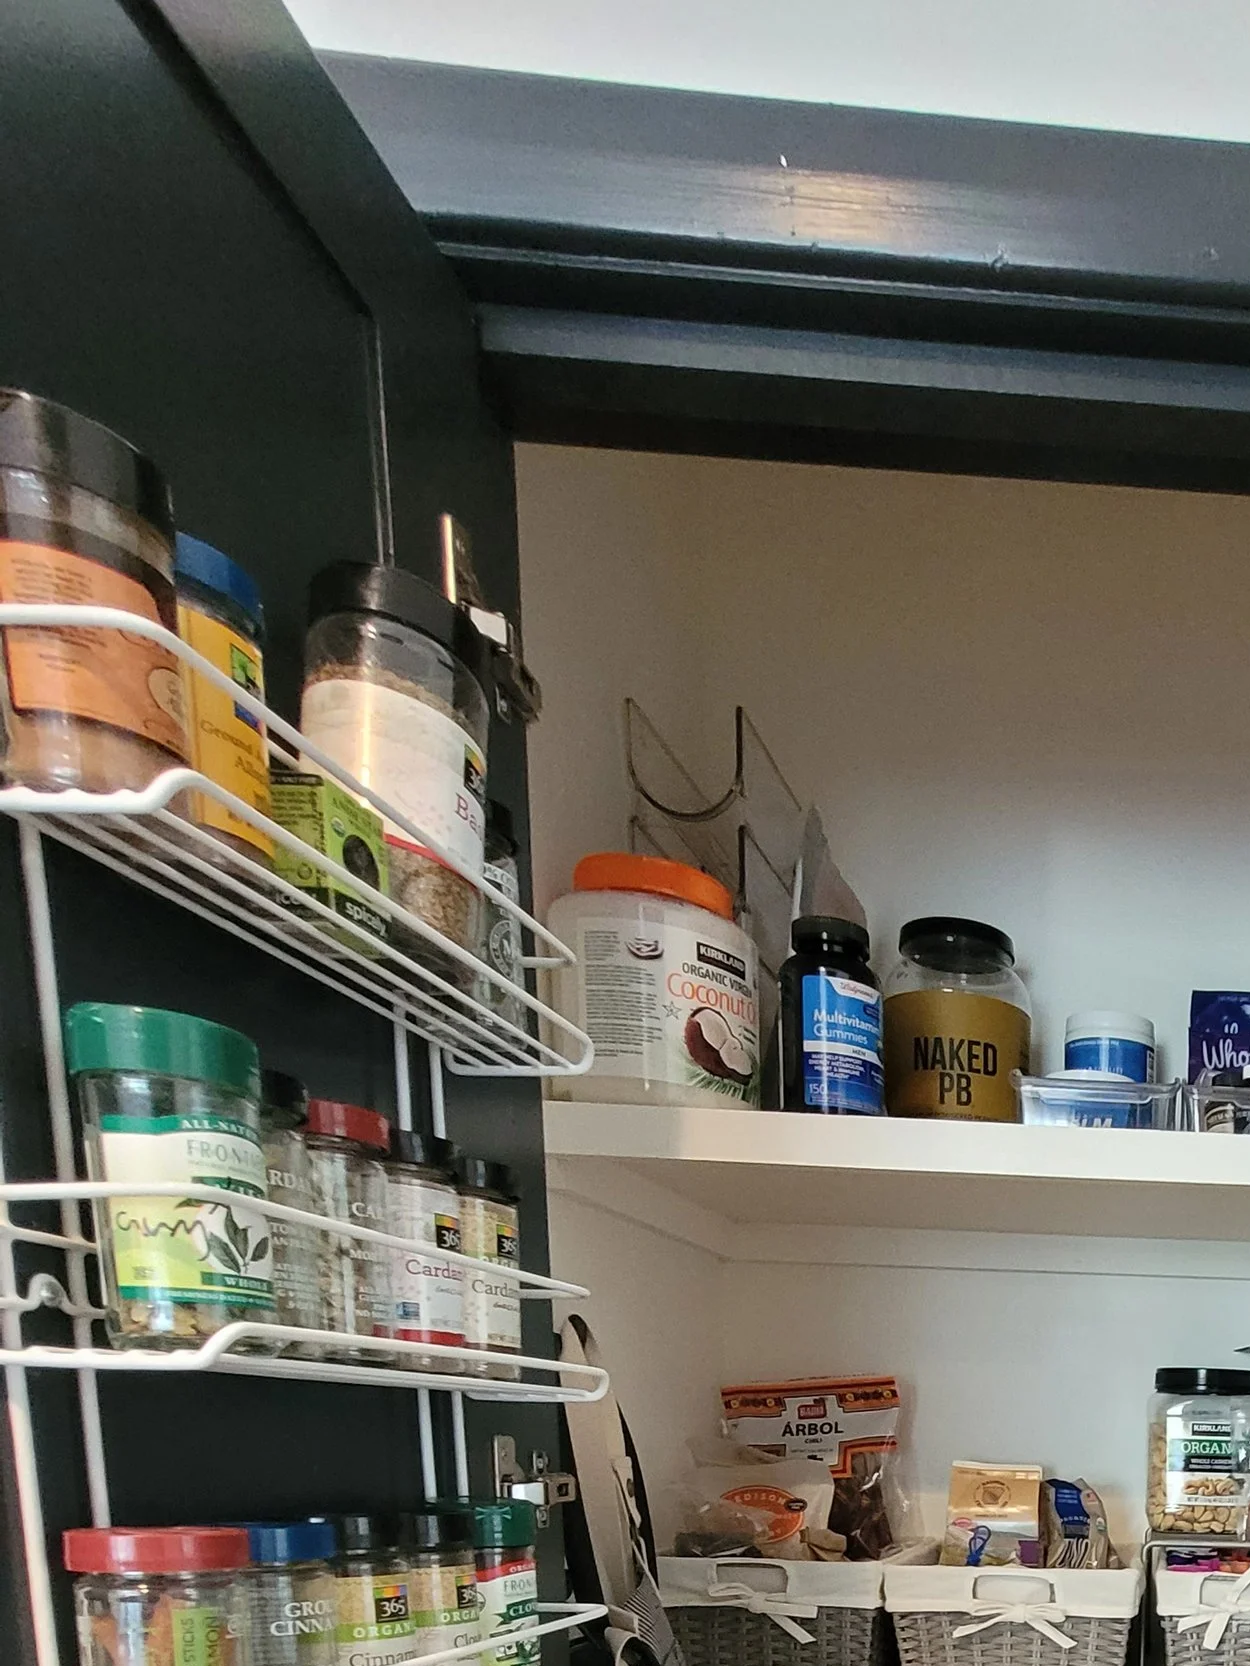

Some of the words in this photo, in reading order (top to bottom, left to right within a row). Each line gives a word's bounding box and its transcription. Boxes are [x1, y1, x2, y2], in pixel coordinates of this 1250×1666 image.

[700, 945, 745, 971] KIRKLAND
[682, 962, 728, 987] ORGANIC
[667, 972, 746, 1021] Coconut
[813, 1025, 868, 1046] Gummies
[852, 1048, 867, 1057] MEN
[913, 1036, 998, 1077] NAKED
[809, 1083, 826, 1095] 150
[939, 1071, 973, 1107] PB
[782, 1421, 844, 1437] ÁRBOL
[380, 1598, 407, 1618] 365
[181, 1617, 196, 1664] STICKS
